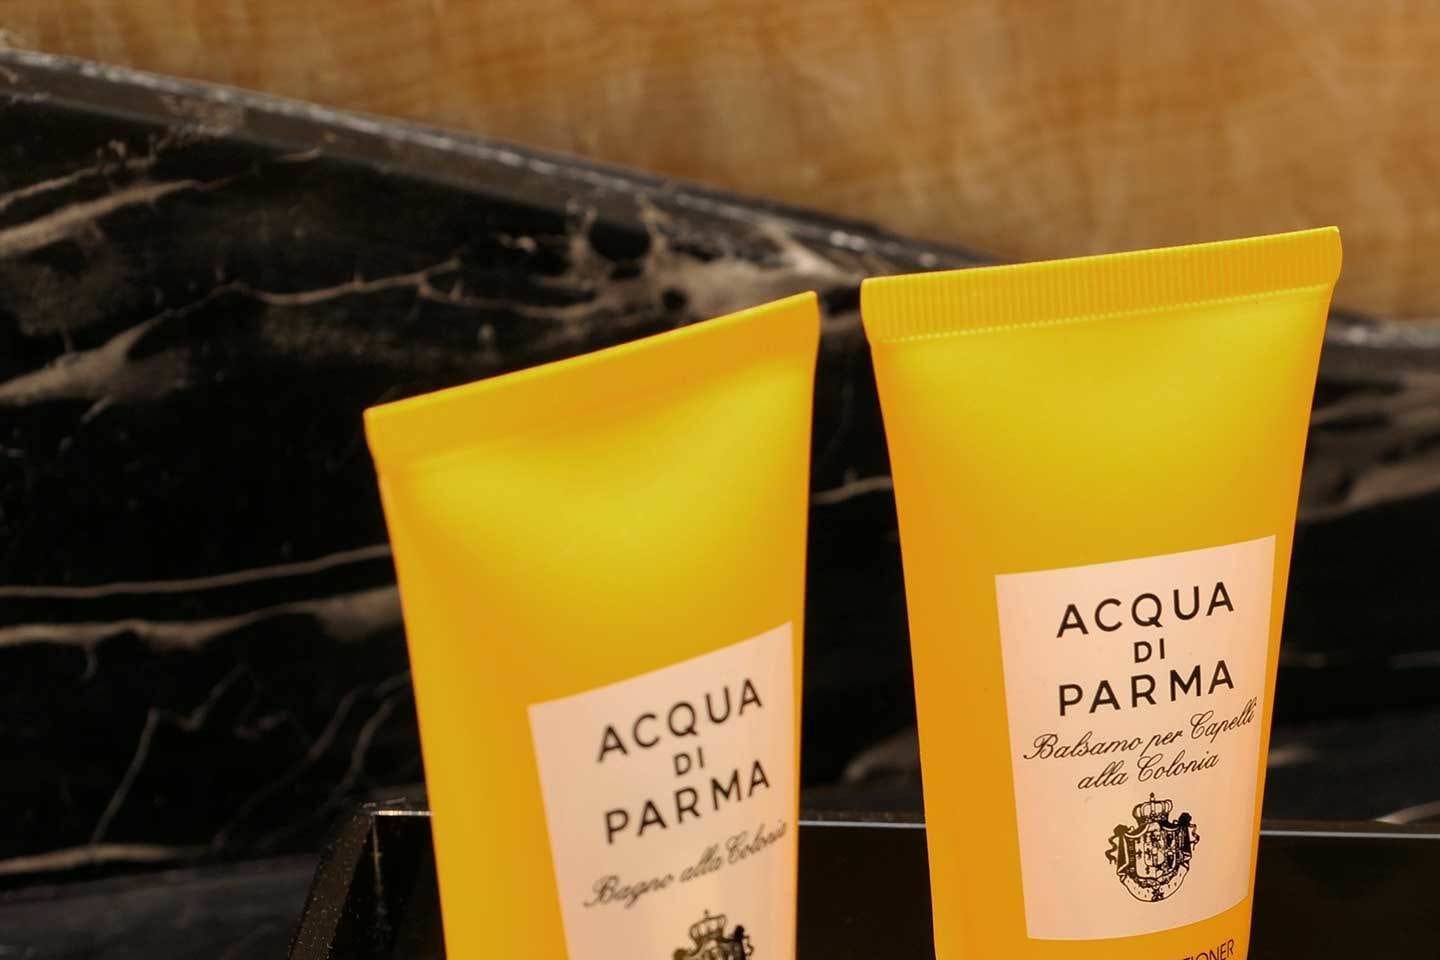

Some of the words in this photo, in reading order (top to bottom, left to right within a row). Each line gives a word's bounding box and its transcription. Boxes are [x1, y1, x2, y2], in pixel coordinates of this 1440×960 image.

[1056, 581, 1234, 638] ACQUA
[1133, 638, 1166, 663] DI
[1058, 660, 1235, 717] PARMA
[597, 678, 762, 762] ACQUA
[1023, 731, 1143, 760] Balsamo
[1140, 730, 1183, 757] per
[1190, 697, 1257, 743] Capelli
[674, 747, 704, 776] DI
[1077, 760, 1128, 790] alla
[1137, 750, 1220, 783] Colonia
[604, 760, 769, 844] PARMA
[584, 873, 674, 908] Bagno
[681, 845, 723, 882] alla
